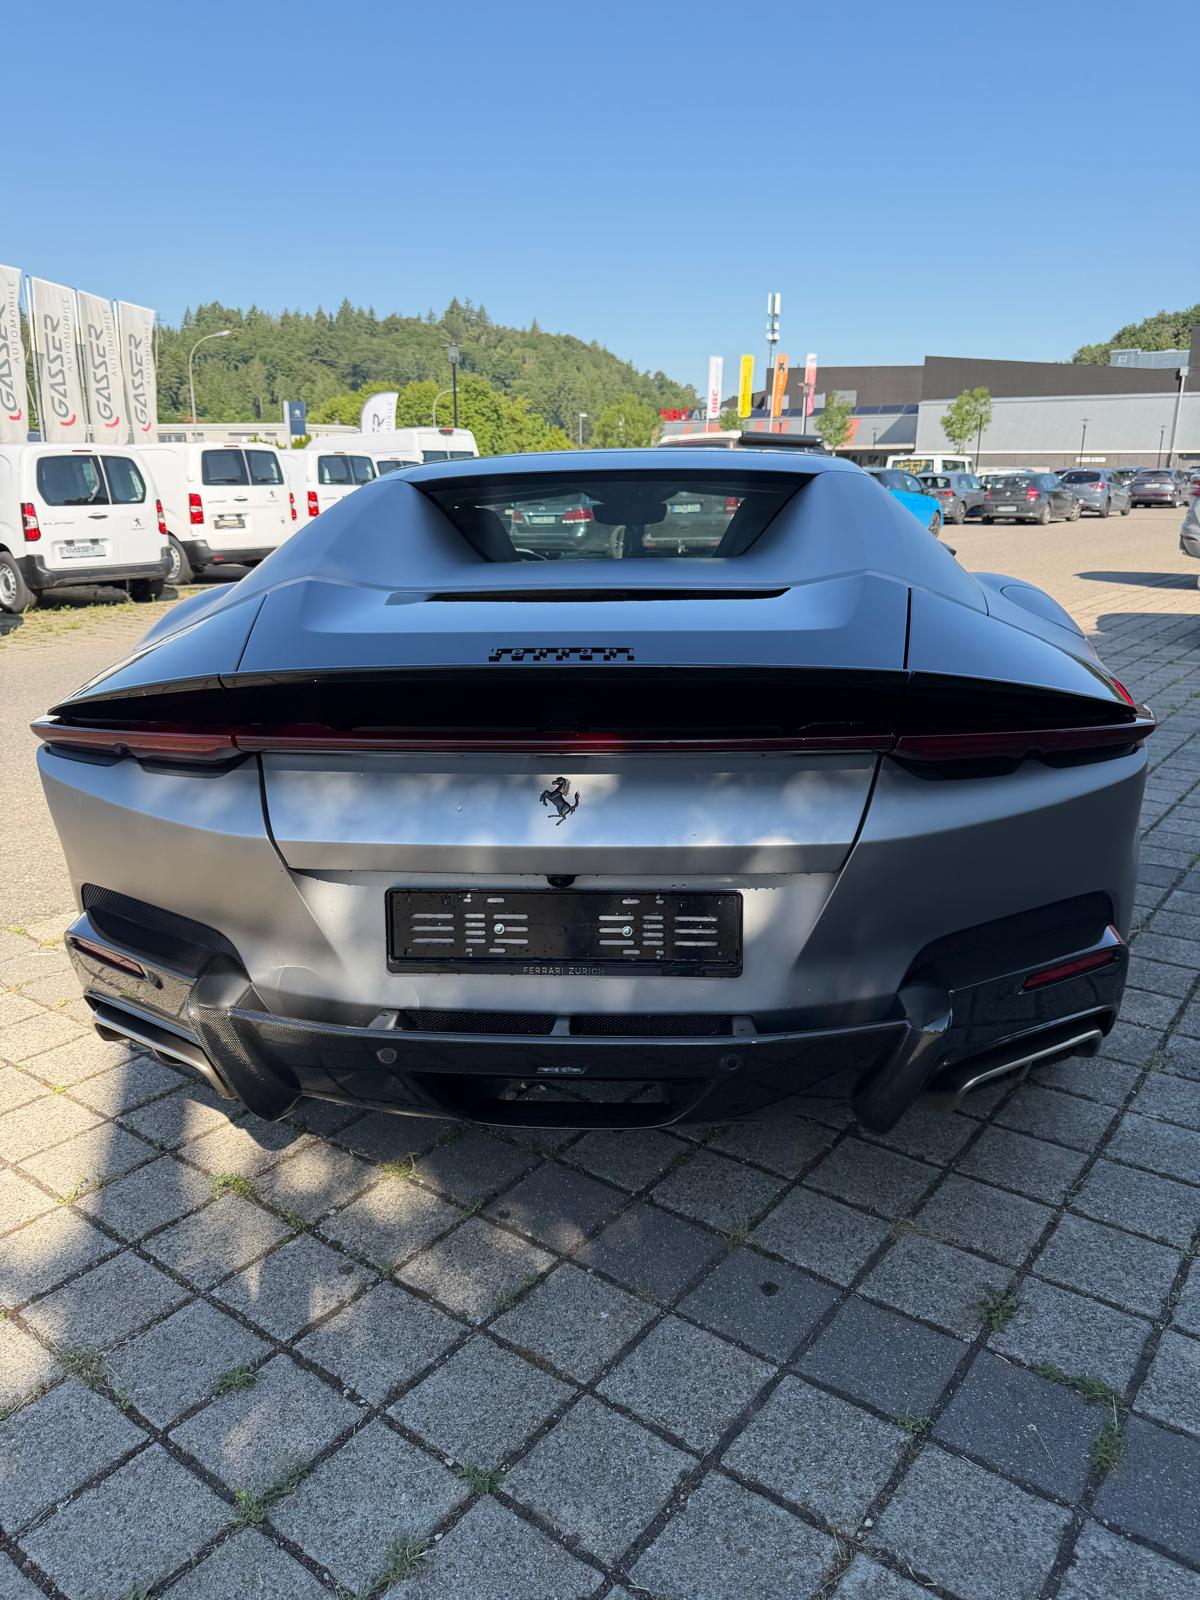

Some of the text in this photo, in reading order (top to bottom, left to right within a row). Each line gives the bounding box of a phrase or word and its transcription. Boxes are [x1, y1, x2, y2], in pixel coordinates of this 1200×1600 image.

[0, 303, 18, 412] GASSE
[8, 280, 20, 364] AUTOMOBILE
[44, 313, 70, 418] GASSER
[62, 299, 73, 372] AUTOMOBILE
[87, 323, 114, 420] GASSER
[128, 333, 149, 424] GASSER
[523, 966, 564, 975] FERRARI
